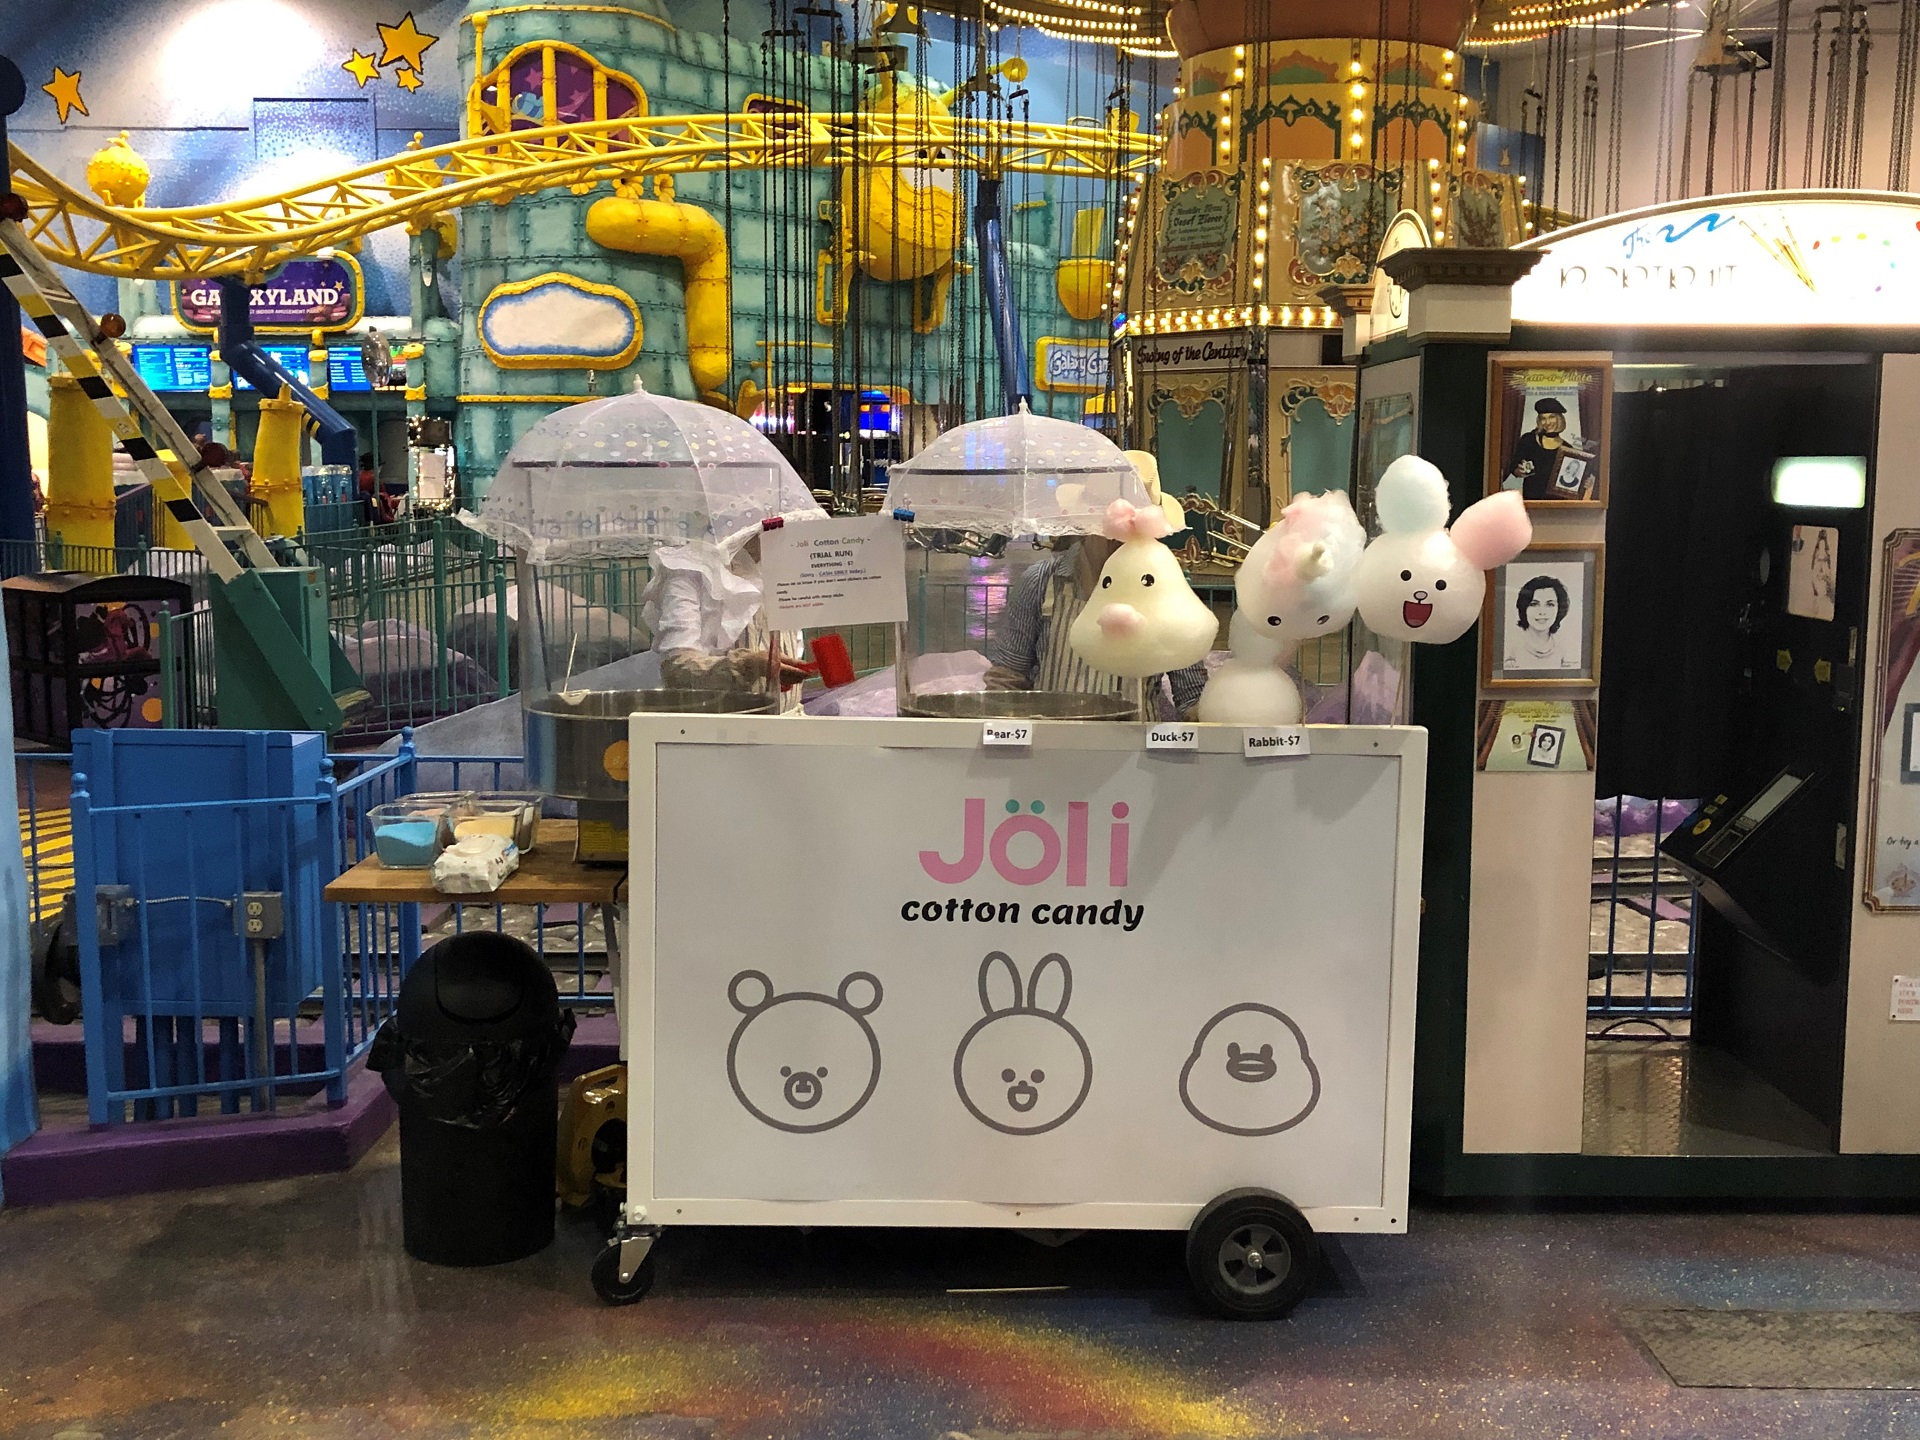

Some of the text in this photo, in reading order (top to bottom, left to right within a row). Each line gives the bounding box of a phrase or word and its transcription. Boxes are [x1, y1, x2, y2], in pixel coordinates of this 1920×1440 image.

[190, 288, 339, 306] GAXYLAND
[1172, 346, 1184, 365] of
[1185, 345, 1201, 361] the
[1202, 341, 1248, 361] Century
[1049, 349, 1087, 378] Galaxy
[813, 539, 839, 547] Cotton
[841, 537, 865, 545] Candy
[809, 550, 854, 560] (TRIAL RUN)
[986, 728, 1301, 748] Bear-$7 Duck-$7 Rabbit-$7
[1886, 836, 1897, 846] Or
[1899, 836, 1912, 850] try
[900, 898, 1145, 932] cotton candy
